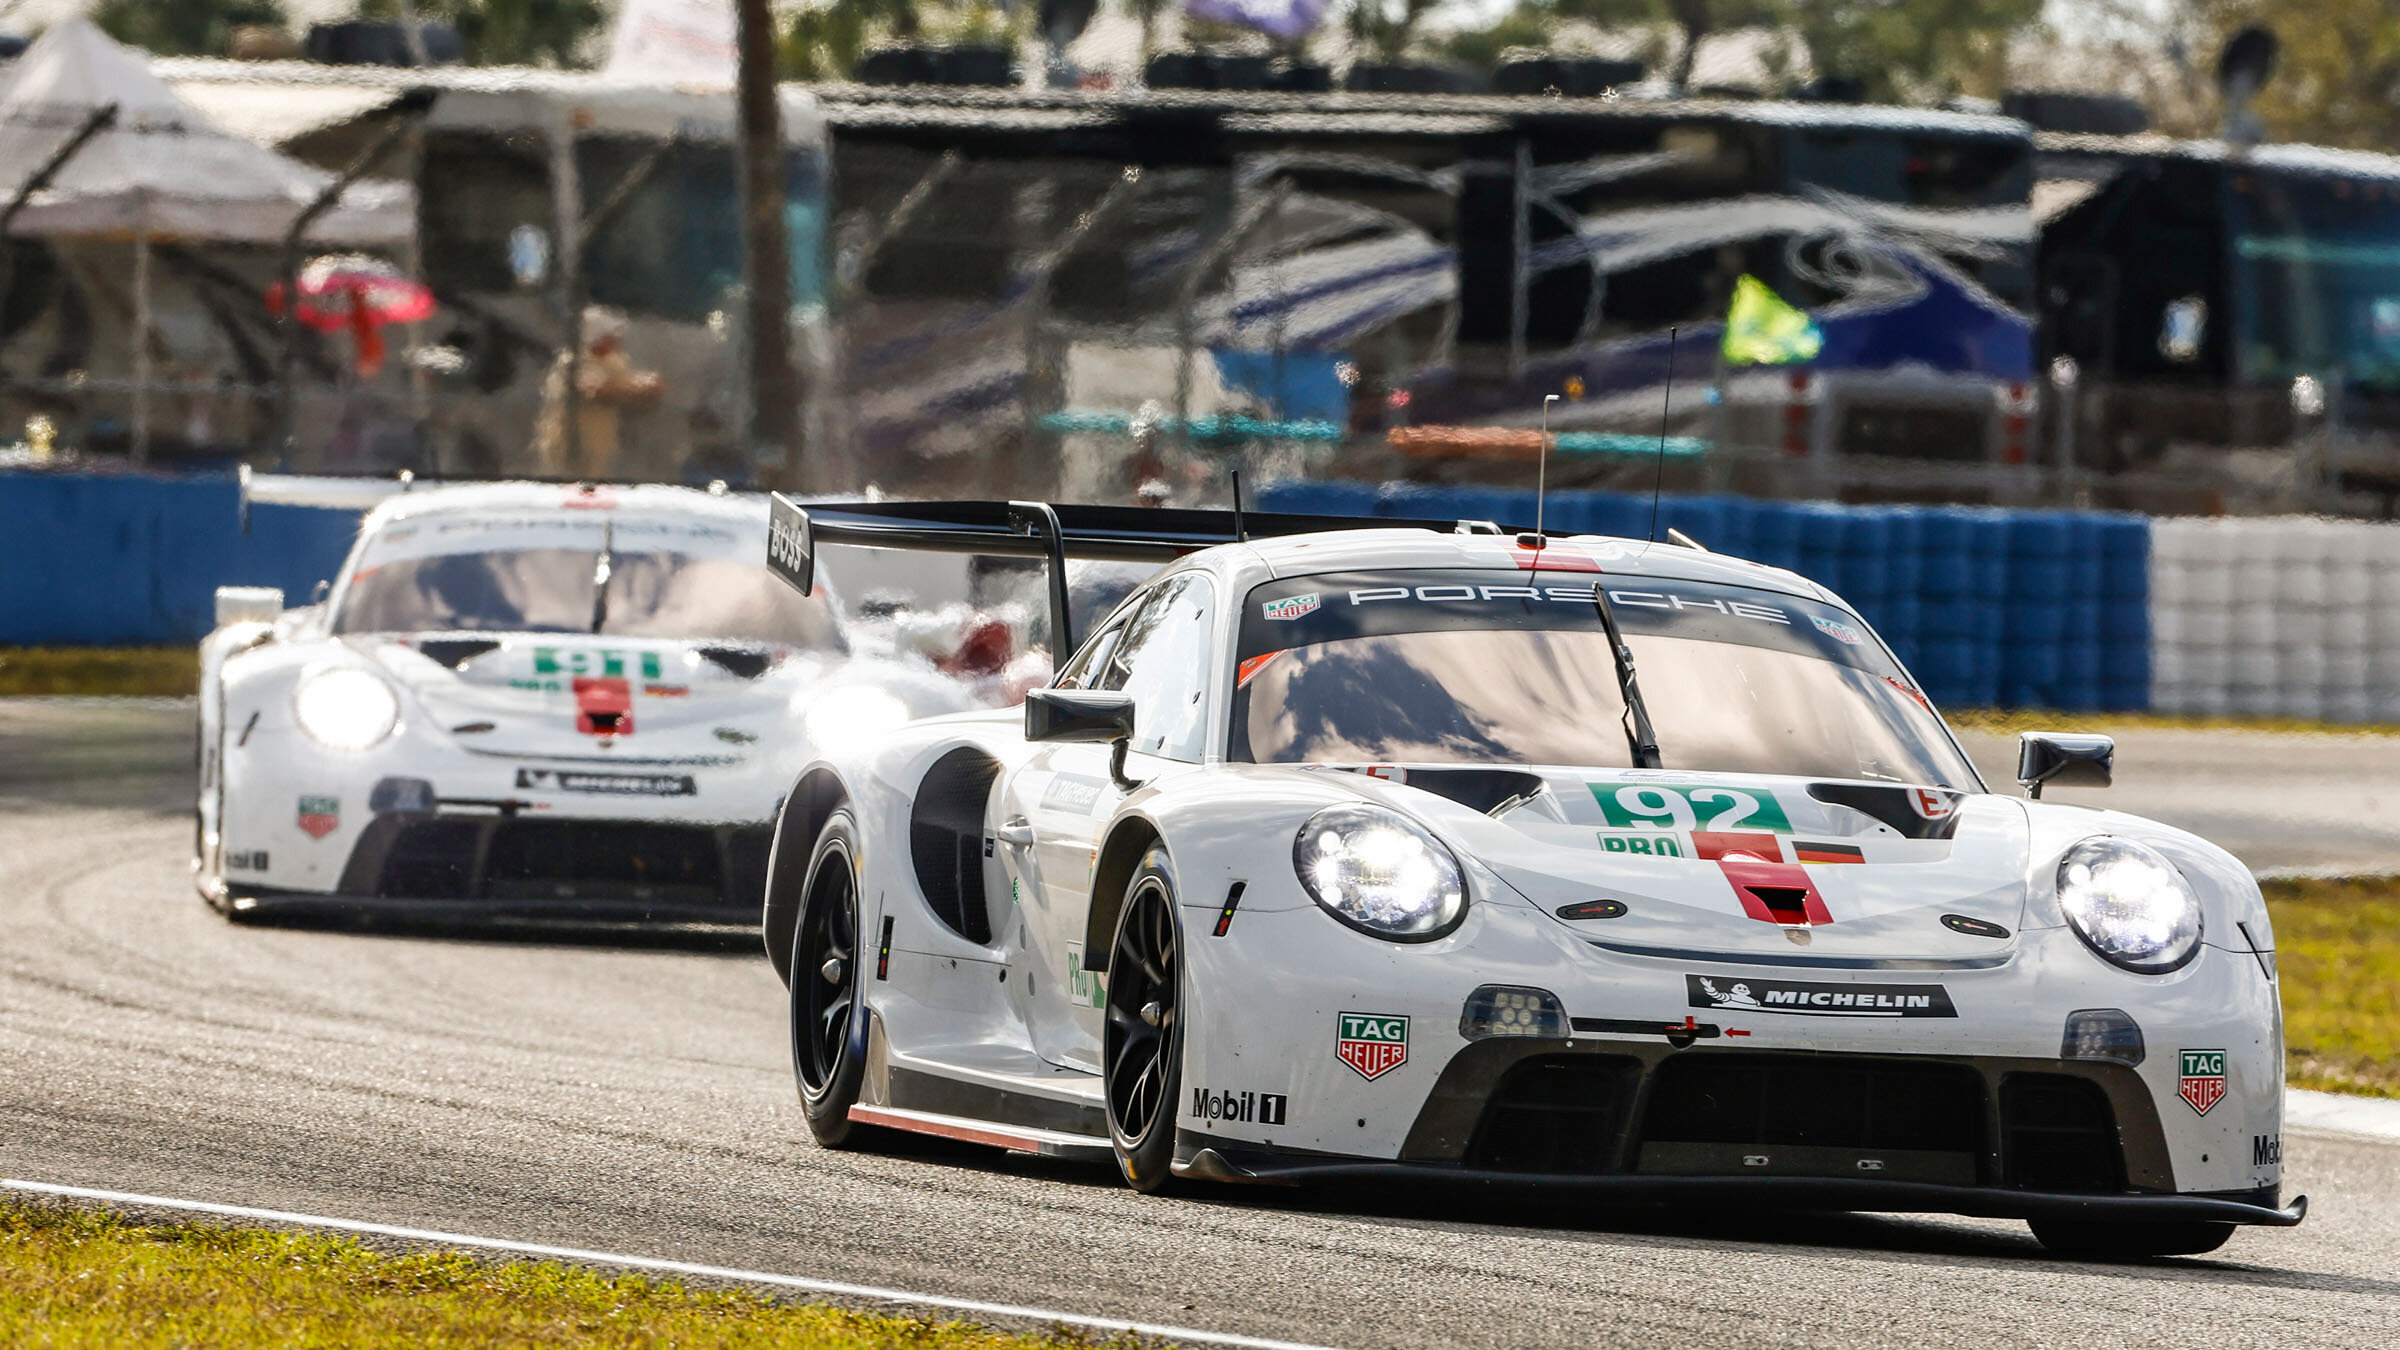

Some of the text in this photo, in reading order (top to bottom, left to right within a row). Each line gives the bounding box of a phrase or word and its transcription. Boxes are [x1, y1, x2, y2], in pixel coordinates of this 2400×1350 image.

[770, 519, 803, 574] BOSS
[1269, 596, 1315, 610] TAG
[1269, 603, 1317, 618] HEUER
[1348, 586, 1792, 625] PORSCHE
[1614, 785, 1776, 832] 92
[1917, 788, 1949, 817] E
[1603, 837, 1685, 858] PRO
[1764, 990, 1930, 1009] MICHELIN
[1345, 1018, 1401, 1040] TAG
[1341, 1043, 1402, 1075] HEUER
[2184, 1055, 2222, 1074] TAG
[1192, 1086, 1255, 1123] Mobil
[2182, 1080, 2224, 1109] HEUER
